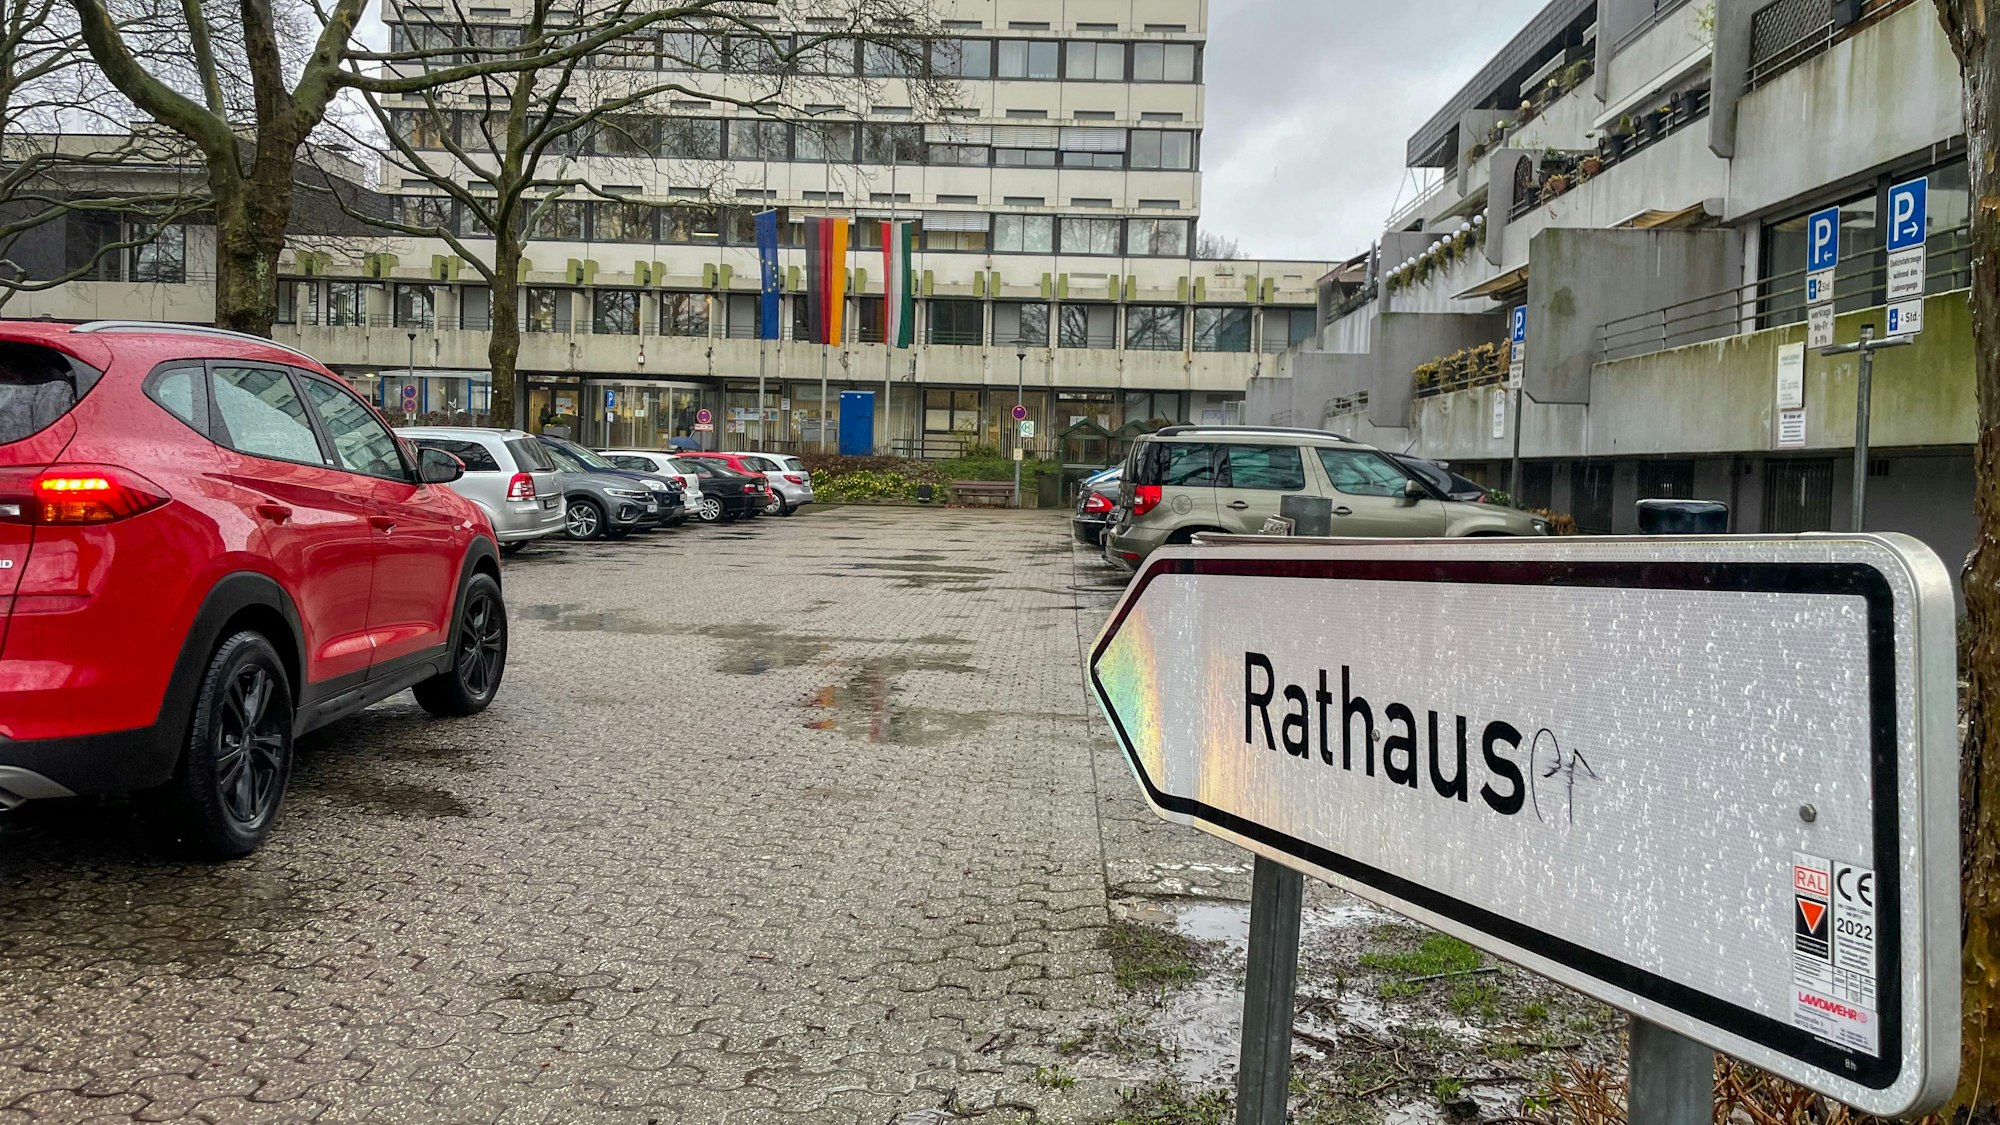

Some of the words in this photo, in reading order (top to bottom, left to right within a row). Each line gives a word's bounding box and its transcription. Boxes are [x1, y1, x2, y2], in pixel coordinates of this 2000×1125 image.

[1893, 191, 1915, 242] P
[1814, 218, 1832, 264] P
[1817, 278, 1822, 292] 2
[1514, 311, 1523, 339] P
[1245, 651, 1525, 815] Rathaus
[1797, 870, 1826, 892] RAL
[1836, 917, 1873, 941] 2022
